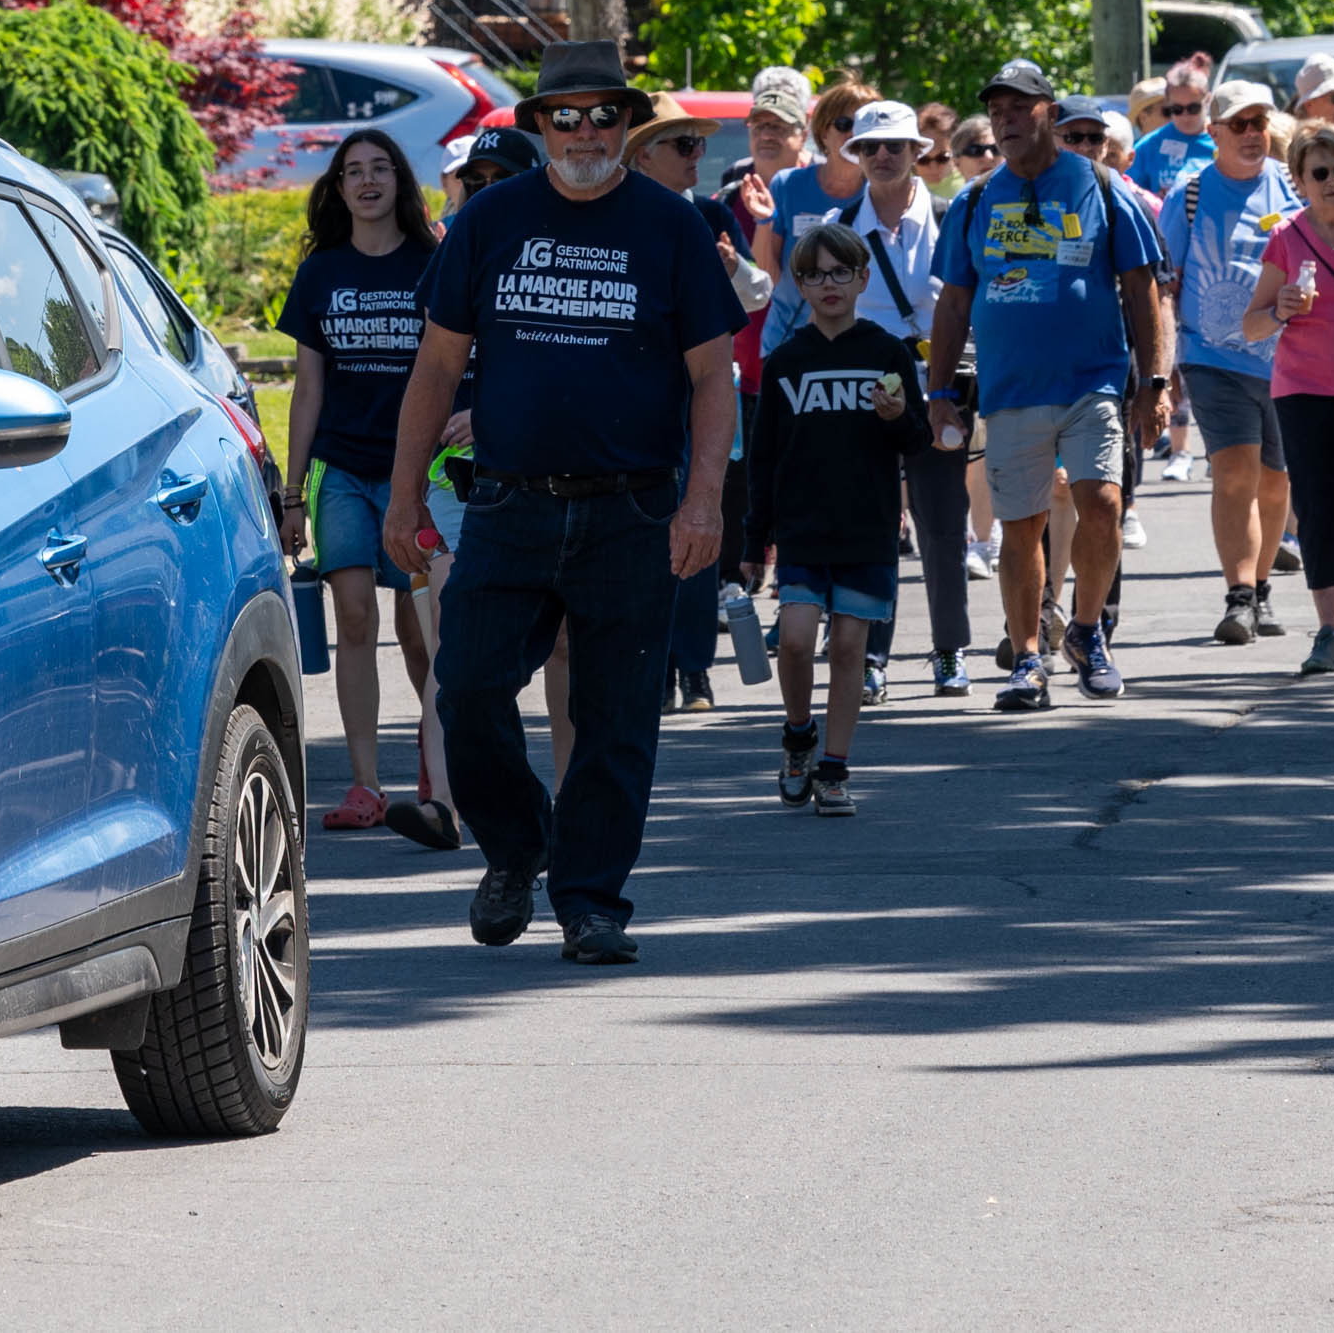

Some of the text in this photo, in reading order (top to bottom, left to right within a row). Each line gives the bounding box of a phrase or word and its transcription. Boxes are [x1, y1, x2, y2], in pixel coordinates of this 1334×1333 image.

[521, 240, 629, 268] IG GESTION DE
[554, 256, 628, 274] PATRIMOINE
[497, 274, 638, 303] LA MARCHE POUR
[332, 291, 358, 312] IG
[359, 290, 402, 302] GESTION
[360, 300, 417, 312] PATRIMOINE
[495, 294, 636, 320] L'ALZHEIMER
[334, 317, 388, 334] MARCHE
[779, 370, 884, 415] VANS
